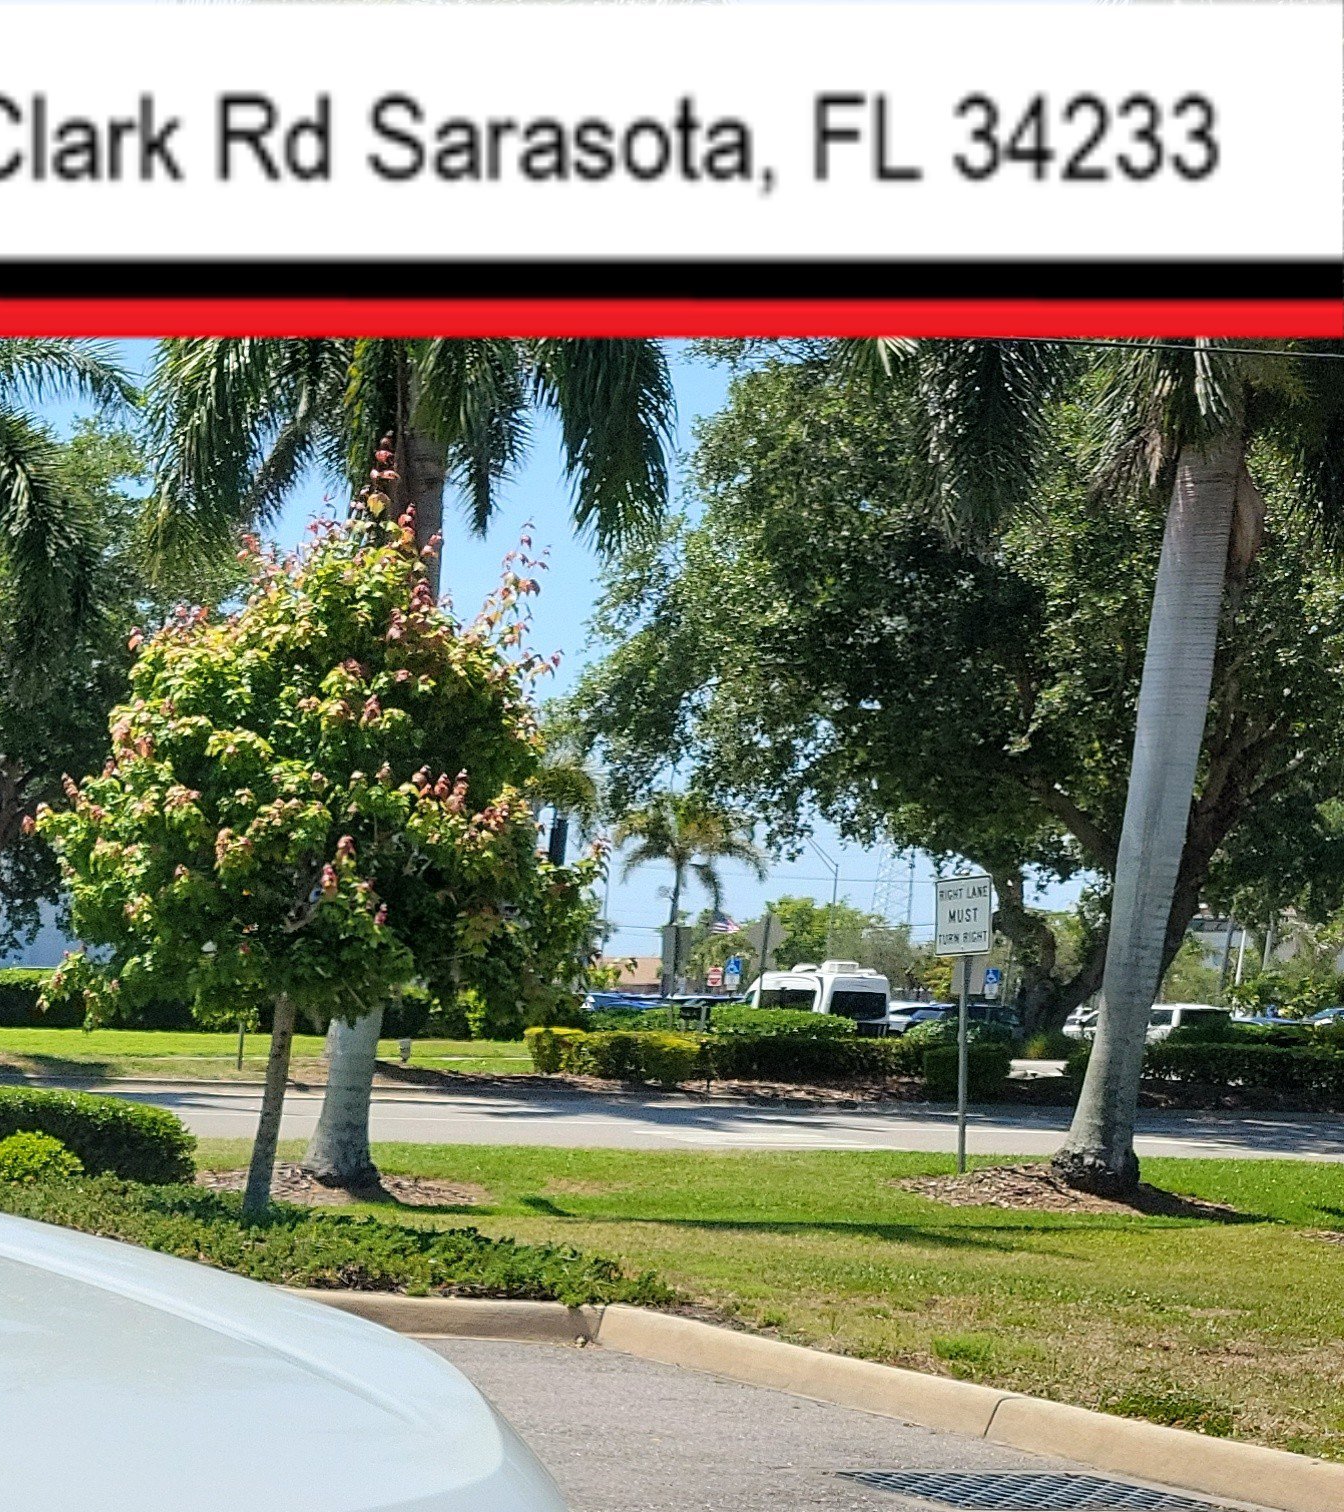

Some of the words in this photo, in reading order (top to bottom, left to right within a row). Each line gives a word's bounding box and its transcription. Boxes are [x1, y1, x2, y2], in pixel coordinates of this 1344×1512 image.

[939, 888, 963, 901] RIGHT
[966, 885, 988, 899] LANE
[948, 908, 978, 923] MUST
[939, 933, 960, 945] TURN
[963, 930, 987, 943] RIGHT
